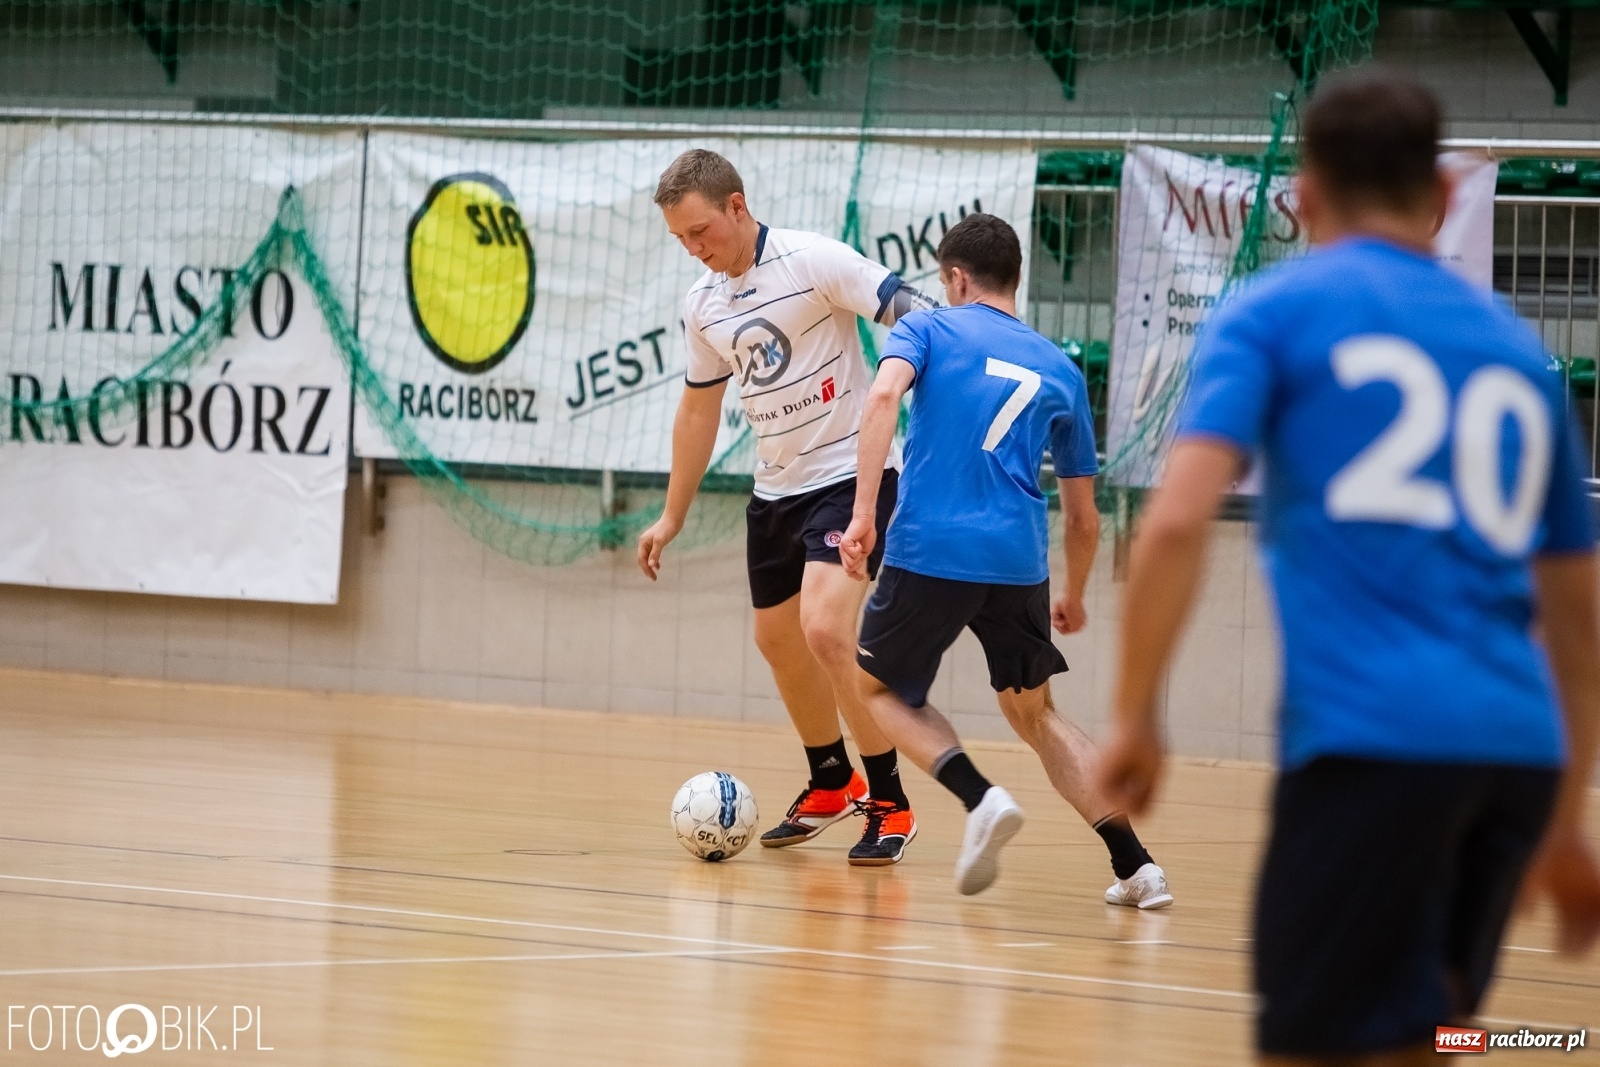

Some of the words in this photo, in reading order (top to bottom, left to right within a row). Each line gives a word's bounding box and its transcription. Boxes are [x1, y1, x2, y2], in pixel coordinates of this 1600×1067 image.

[465, 204, 524, 247] SIR
[47, 261, 295, 341] MIASTO
[399, 379, 539, 423] RACIBÓRZ
[566, 327, 666, 408] JEST
[782, 393, 821, 416] DUDA
[981, 357, 1041, 452] 7
[7, 359, 333, 457] RACIBÓRZ
[1325, 332, 1554, 557] 20
